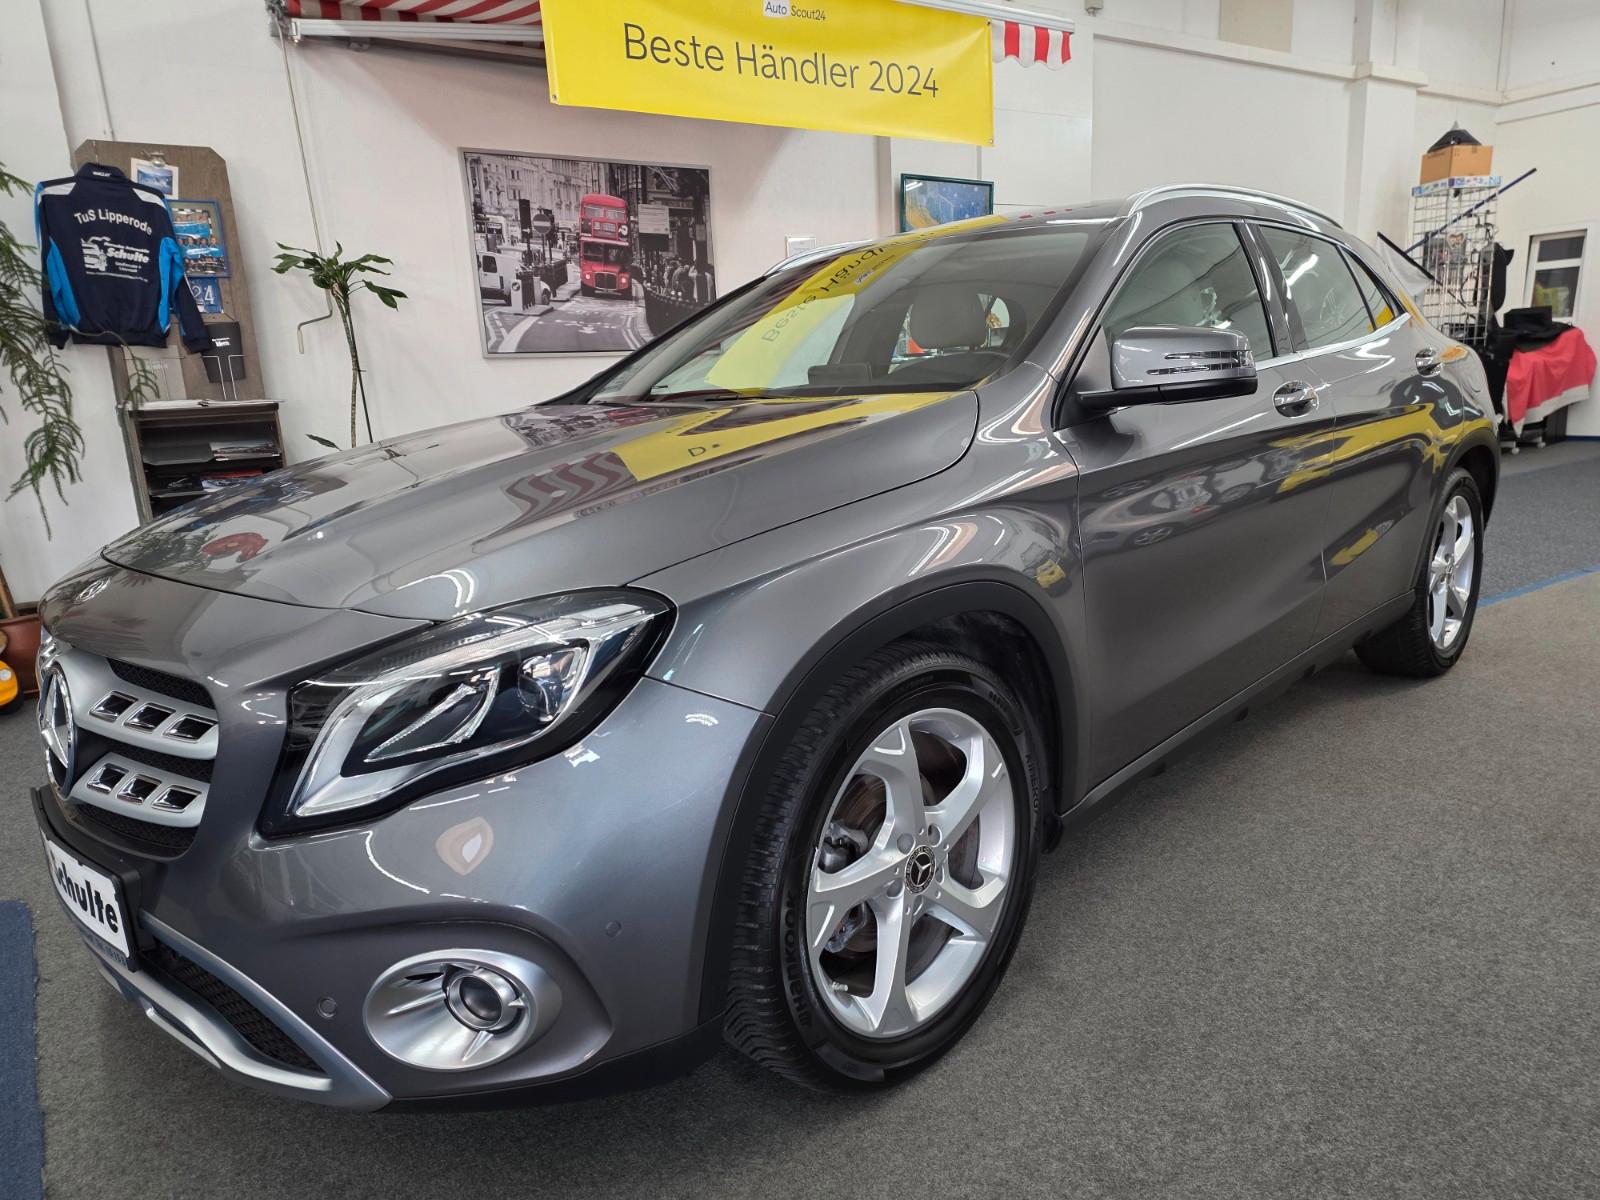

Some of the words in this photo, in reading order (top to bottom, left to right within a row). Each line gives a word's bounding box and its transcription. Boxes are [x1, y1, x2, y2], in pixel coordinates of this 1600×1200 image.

[765, 1, 788, 15] Auto
[791, 5, 826, 21] Scout24
[623, 22, 725, 73] Beste
[736, 41, 860, 90] Händler
[869, 60, 939, 98] 2024
[74, 209, 97, 225] TuS
[98, 208, 153, 236] Lipperode
[106, 247, 149, 263] Schulte
